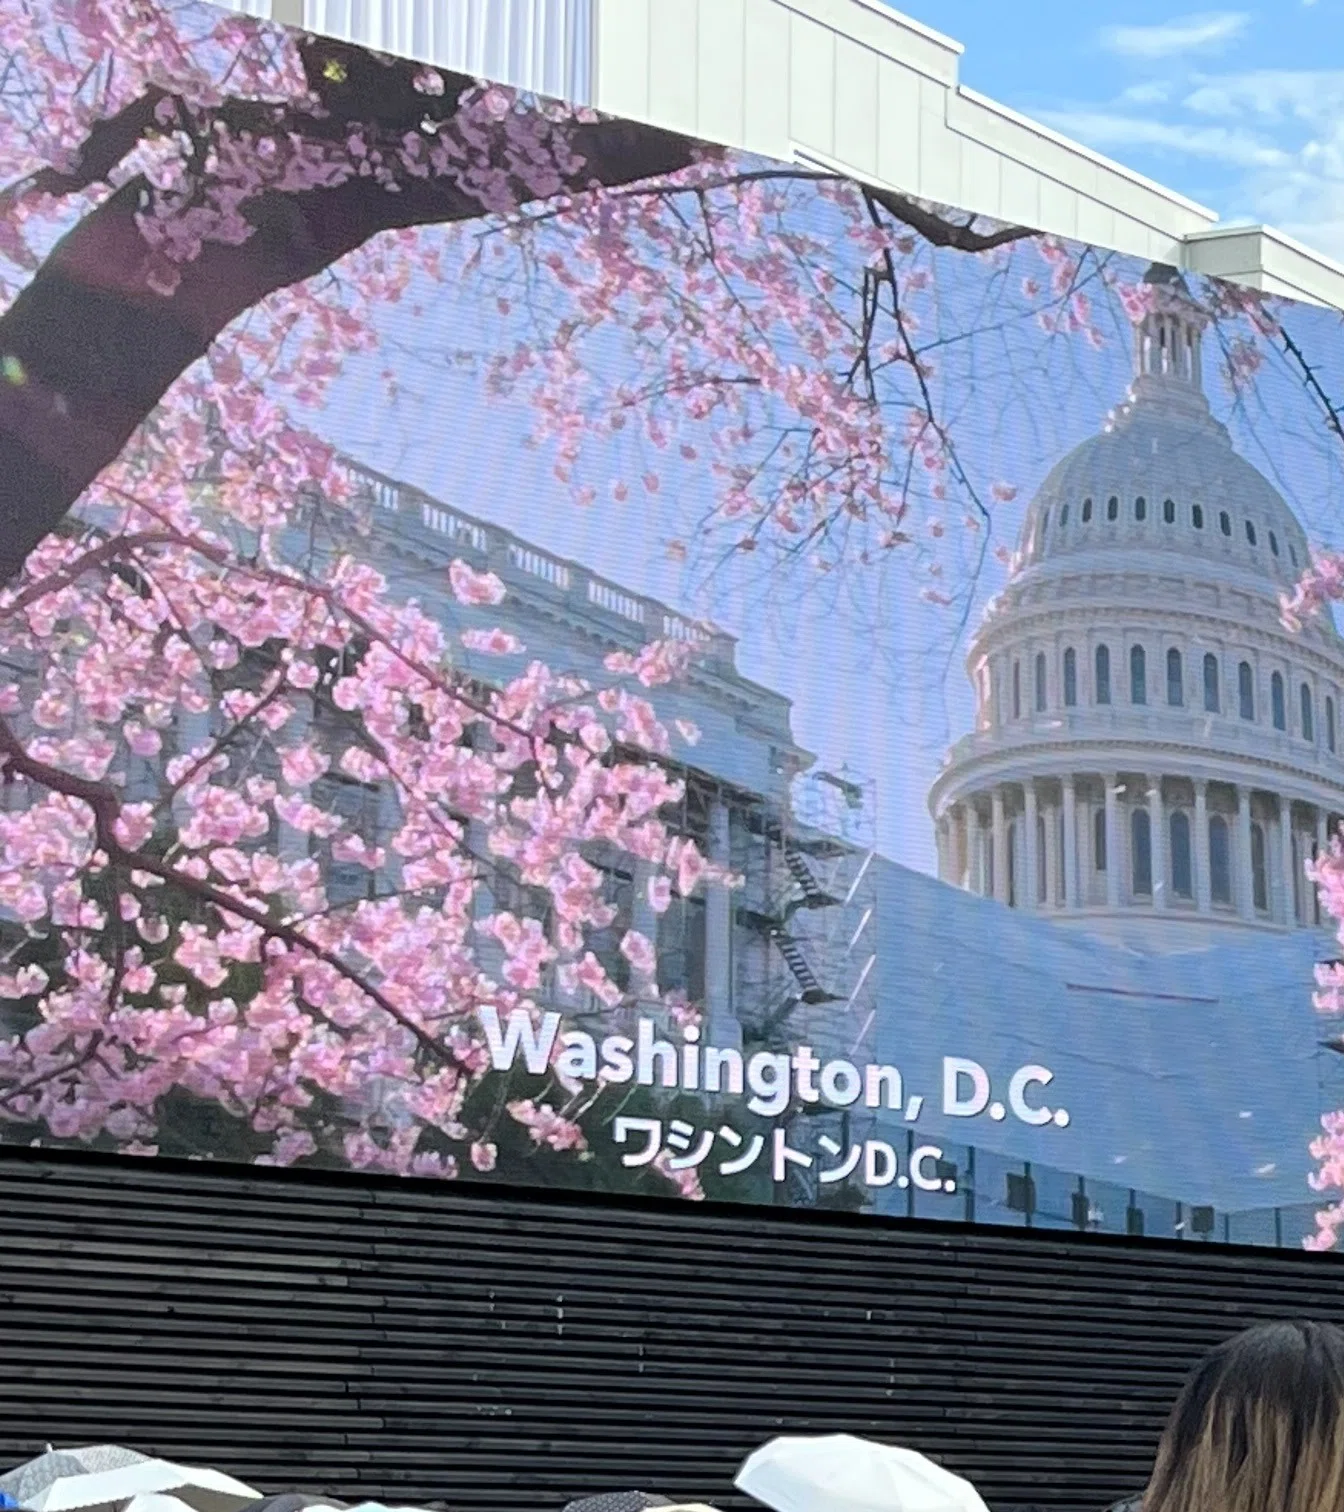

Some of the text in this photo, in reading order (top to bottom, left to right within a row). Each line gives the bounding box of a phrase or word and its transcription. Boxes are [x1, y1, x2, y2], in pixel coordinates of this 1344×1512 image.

[478, 1005, 1070, 1128] Washington, D.C.
[613, 1115, 956, 1193] ワシントンD.C.
